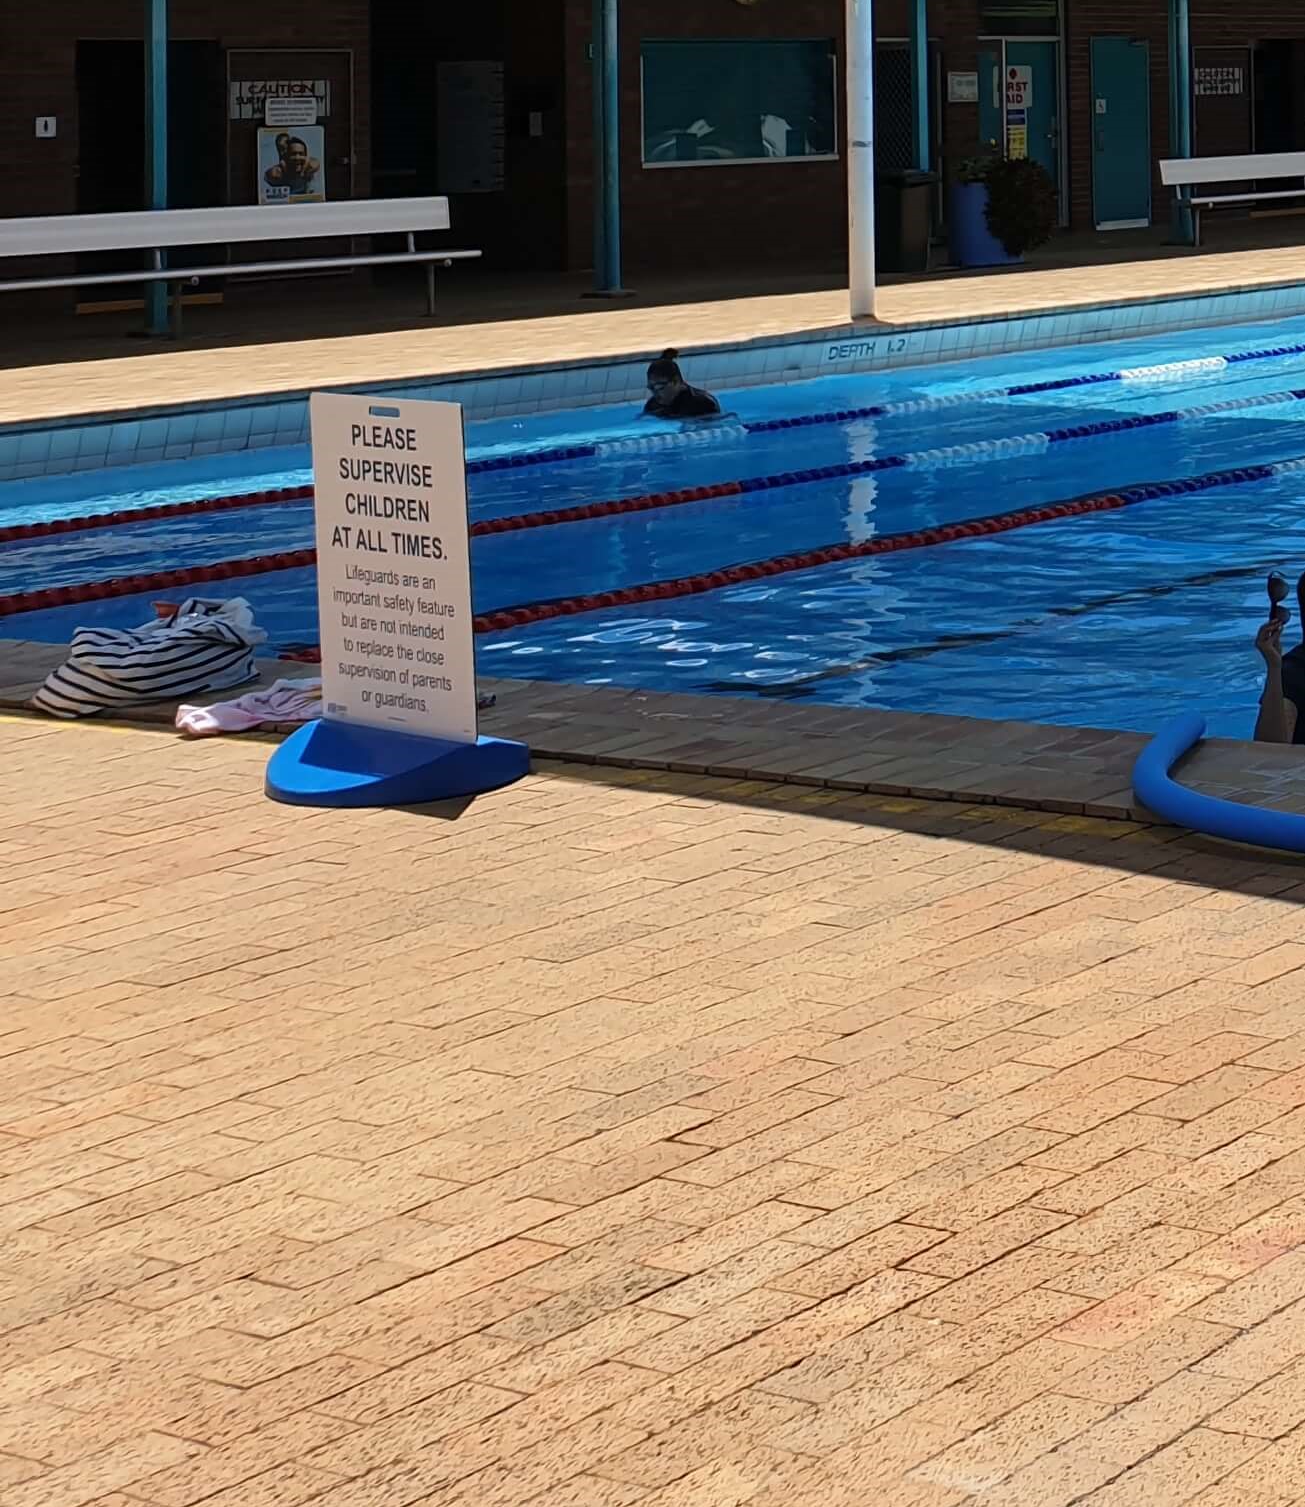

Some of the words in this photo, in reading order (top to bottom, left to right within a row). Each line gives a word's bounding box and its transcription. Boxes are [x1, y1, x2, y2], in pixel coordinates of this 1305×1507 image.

[248, 82, 313, 94] CAUTION
[828, 341, 876, 360] DEPTH
[352, 424, 417, 451] PLEASE
[339, 457, 433, 488] SUPERVISE
[345, 493, 430, 523] CHILDREN
[332, 526, 351, 549] AT
[356, 528, 388, 553] ALL
[392, 532, 448, 561] TIMES.
[345, 564, 399, 586] Lifeguards
[402, 574, 419, 588] are
[422, 577, 436, 590] an
[333, 587, 381, 606] important
[383, 594, 414, 616] safety
[417, 597, 455, 618] feature
[341, 612, 358, 628] but
[361, 617, 377, 631] are
[380, 619, 396, 634] not
[400, 620, 444, 641] intended
[344, 637, 353, 652] to
[356, 640, 394, 659] replace
[397, 645, 414, 660] the
[416, 647, 444, 666] close
[338, 661, 396, 681] supervision
[399, 669, 409, 685] of
[412, 673, 452, 692] parents
[362, 690, 373, 702] or
[375, 691, 430, 713] guardians.
